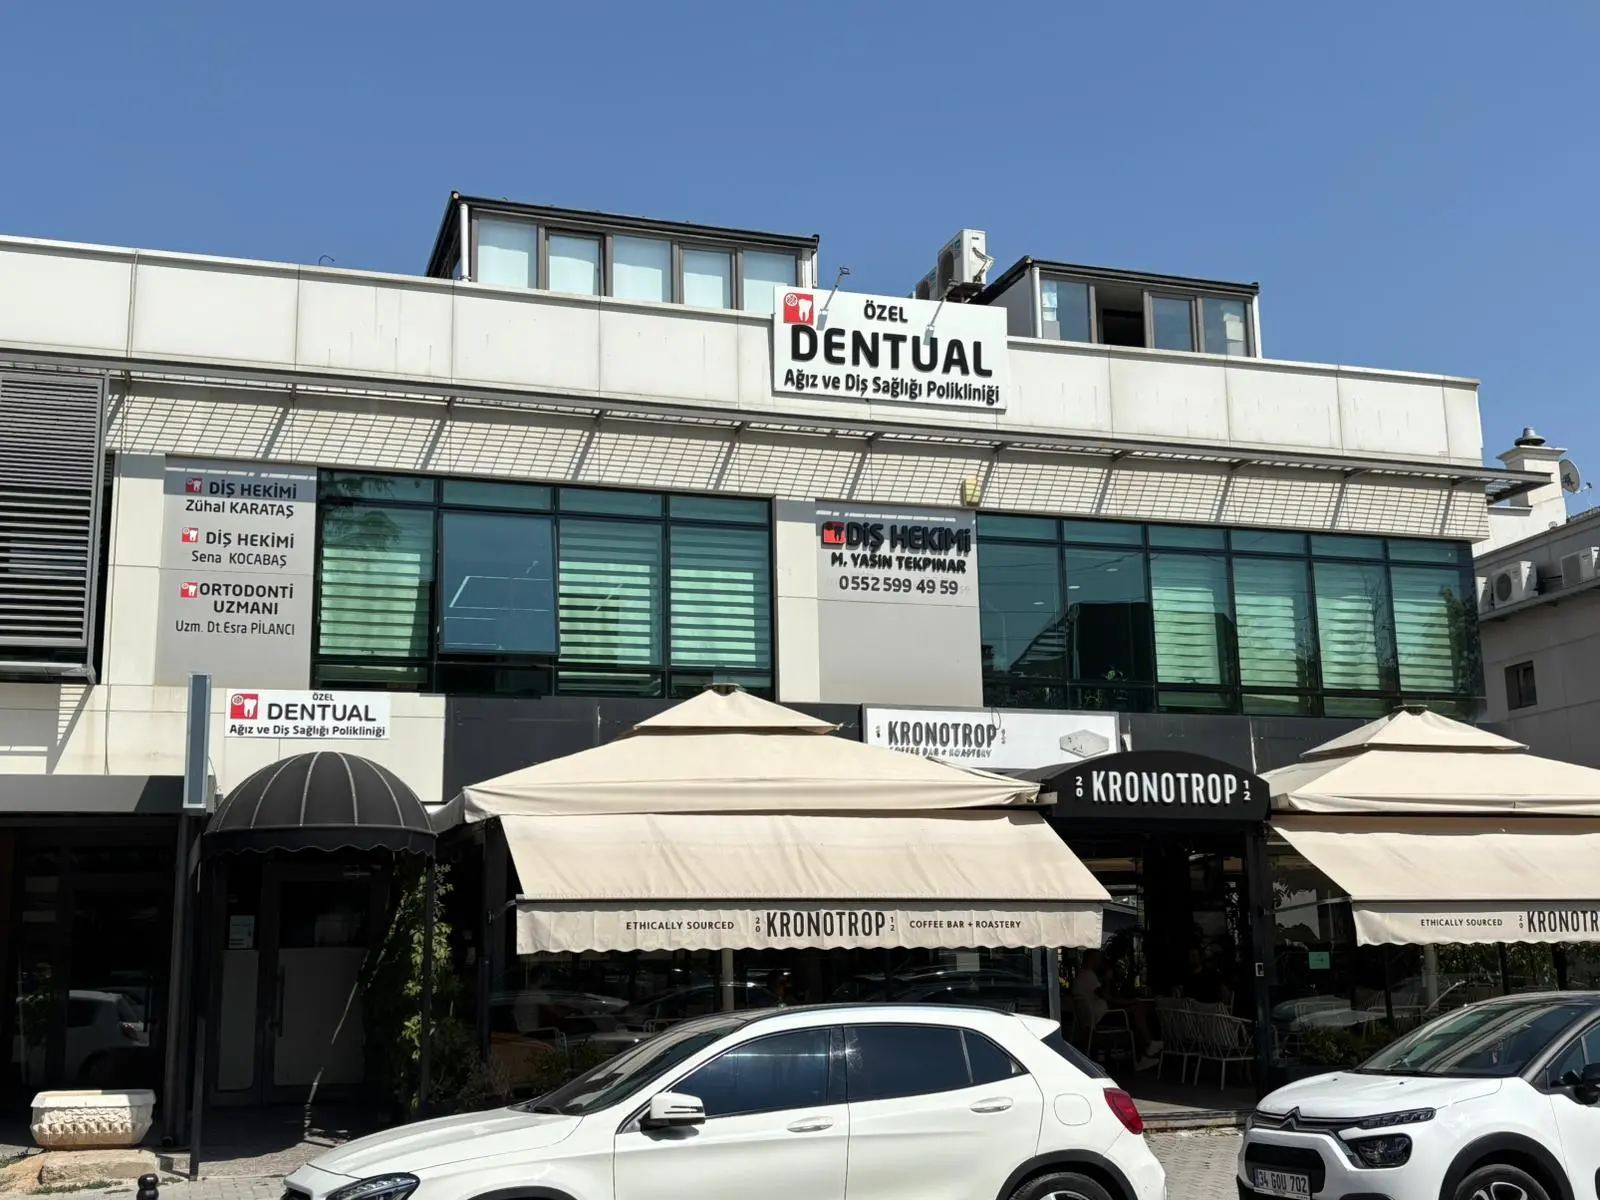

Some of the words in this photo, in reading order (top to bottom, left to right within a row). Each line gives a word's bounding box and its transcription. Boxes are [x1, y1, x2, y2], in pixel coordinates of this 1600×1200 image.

[864, 300, 908, 323] ÖZEL
[791, 324, 993, 377] DENTUAL
[784, 368, 818, 390] Ağız
[822, 375, 841, 389] ve
[845, 373, 868, 397] Diş
[872, 376, 922, 399] Sağlığı
[927, 380, 1000, 405] Polikliniği
[209, 479, 235, 497] DİŞ
[240, 483, 297, 499] HEKİMİ
[185, 499, 225, 513] Zühal
[229, 502, 294, 519] KARATAŞ
[205, 529, 232, 548] DİŞ
[237, 533, 294, 549] HEKİMİ
[846, 521, 884, 553] DİŞ
[890, 524, 971, 554] HEKİMİ
[191, 550, 222, 563] Sena
[229, 552, 287, 568] KOCABAŞ
[831, 552, 847, 567] M.
[896, 556, 966, 574] TEKPINAR
[199, 582, 294, 599] ORTODONTİ
[916, 579, 936, 594] 49
[940, 580, 958, 595] 59
[213, 600, 278, 615] UZMANI
[175, 620, 204, 632] Uzm.
[251, 621, 295, 636] PİLANCI
[312, 692, 335, 701] ÖZEL
[267, 703, 376, 722] DENTUAL
[229, 724, 254, 736] Ağız
[257, 727, 270, 735] ve
[273, 725, 290, 736] Diş
[293, 725, 329, 737] Sağlığı
[332, 726, 385, 737] Polikliniği
[887, 720, 997, 748] KRONOTROP
[1092, 770, 1237, 804] KRONOTROP
[626, 921, 683, 930] ETHICALLY
[686, 921, 735, 930] SOURCED
[766, 911, 885, 937] KRONOTROP
[909, 920, 944, 929] COFFEE
[947, 920, 965, 929] BAR
[975, 920, 1021, 929] ROASTERY
[1421, 919, 1463, 927] ETHICALLY
[1466, 919, 1503, 927] SOURCED
[1527, 910, 1600, 933] KRONOTR
[1259, 1171, 1269, 1187] 34
[1289, 1175, 1308, 1194] 702
